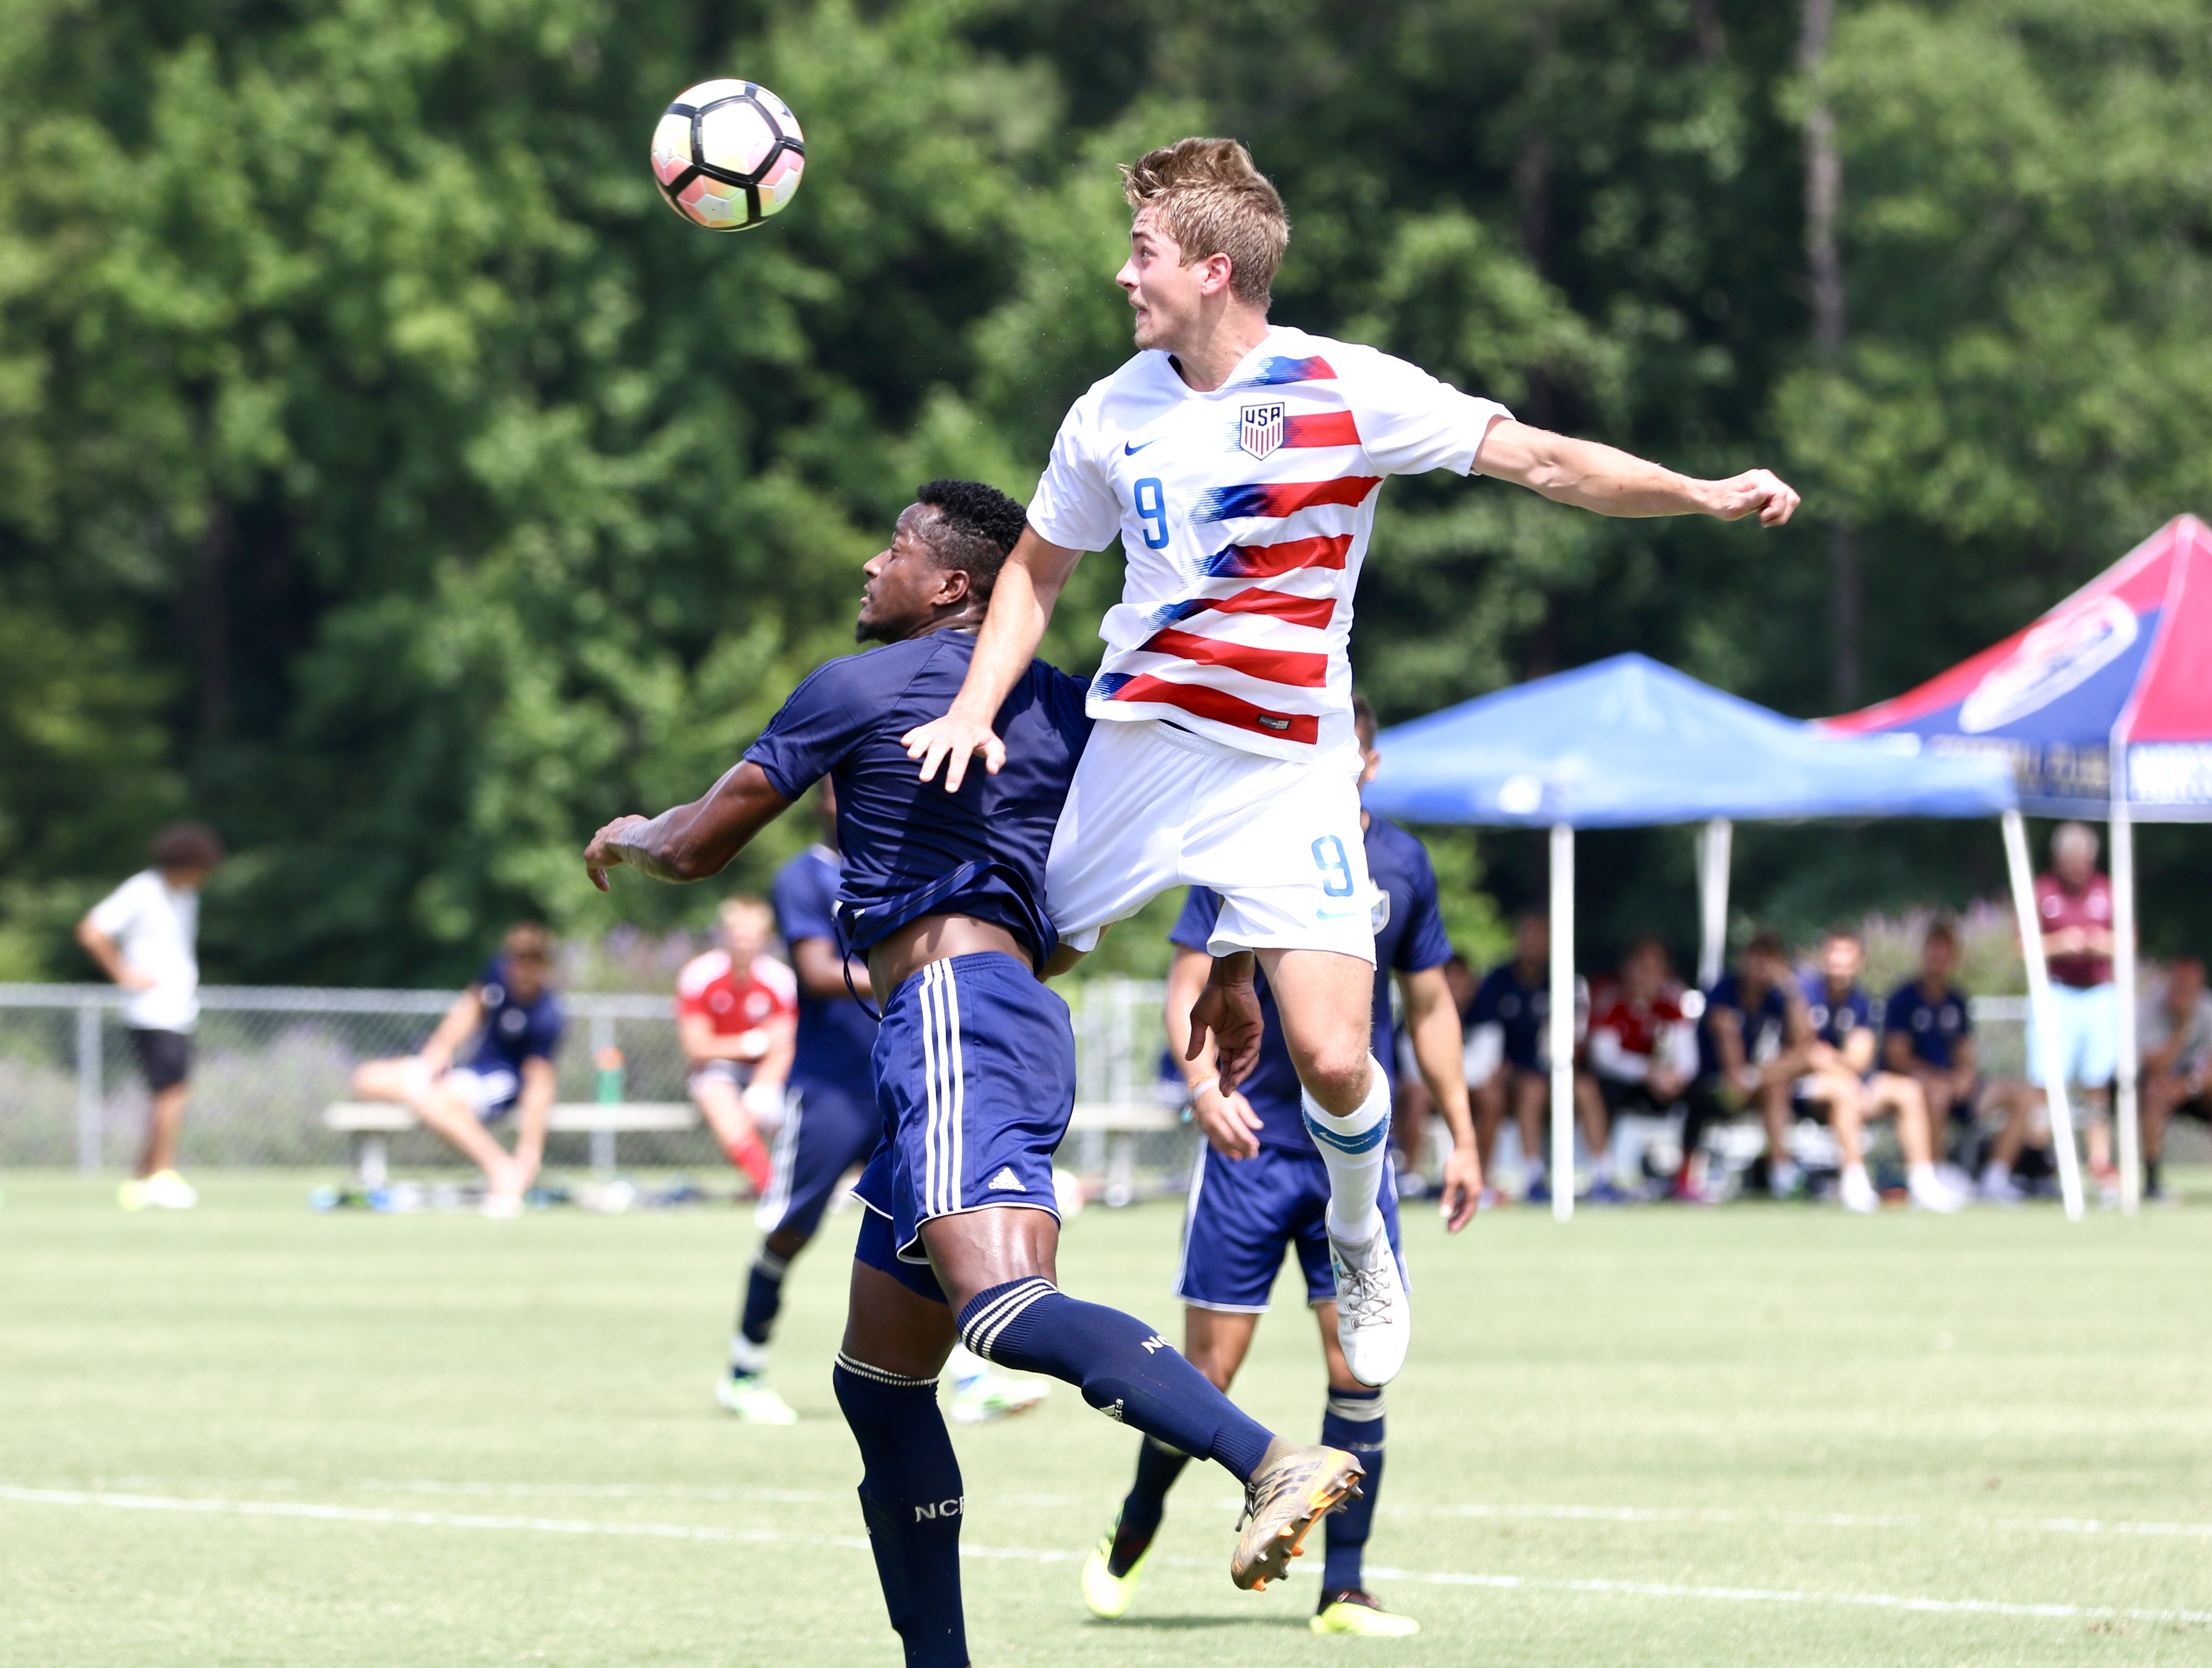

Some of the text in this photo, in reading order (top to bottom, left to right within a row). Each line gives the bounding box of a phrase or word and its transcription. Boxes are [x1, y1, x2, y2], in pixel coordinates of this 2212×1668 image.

[1246, 406, 1280, 427] USA
[1134, 477, 1169, 549] 9
[1312, 835, 1354, 897] 9
